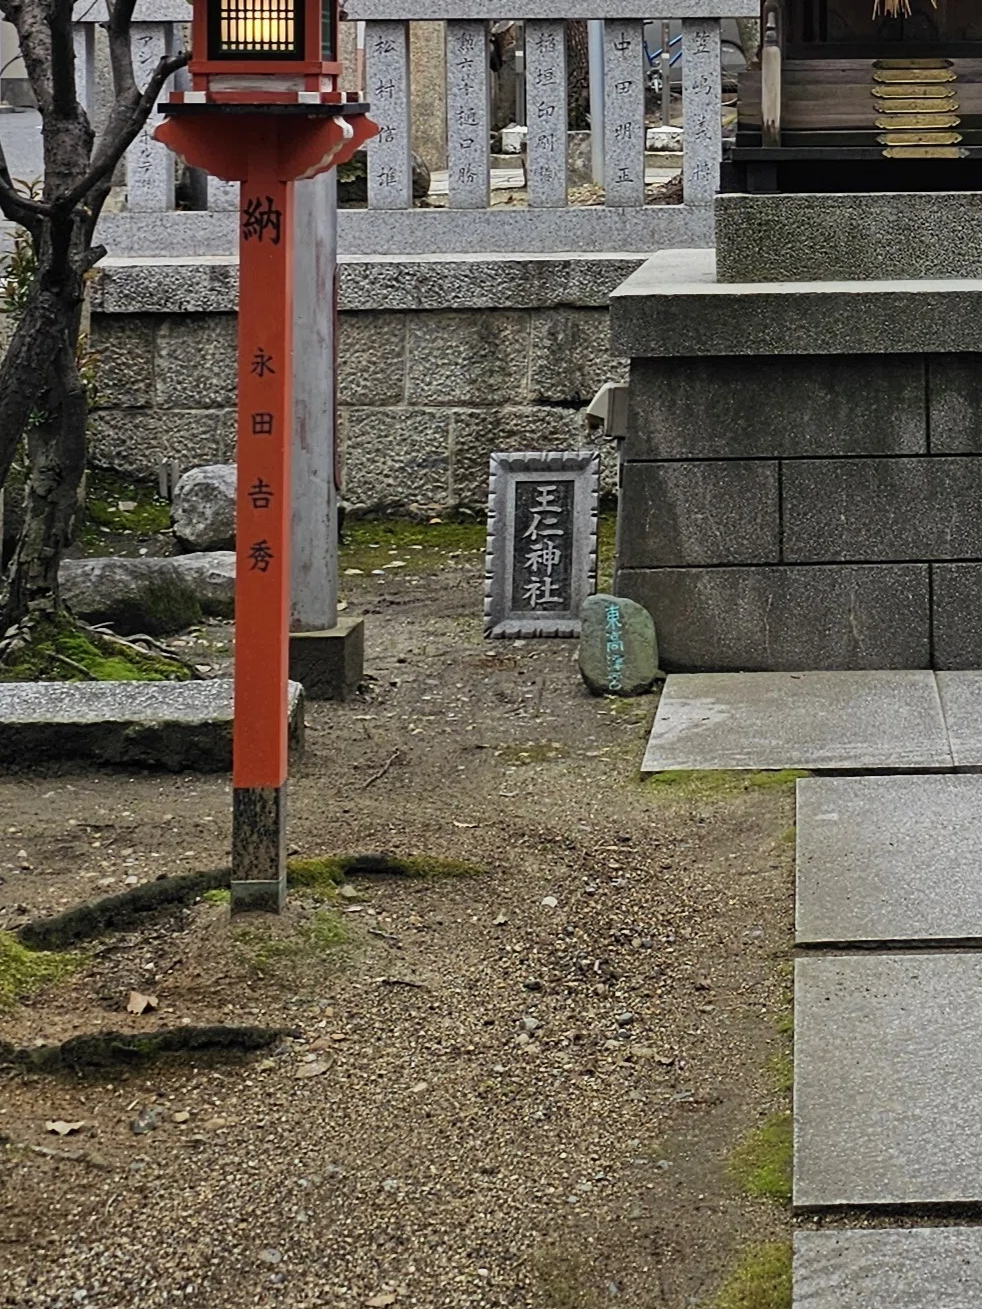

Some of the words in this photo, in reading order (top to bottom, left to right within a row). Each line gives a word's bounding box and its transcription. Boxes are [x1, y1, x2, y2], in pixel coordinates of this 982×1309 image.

[613, 32, 634, 184] 中田明正
[242, 195, 282, 245] 納
[521, 484, 565, 609] 王仁神社
